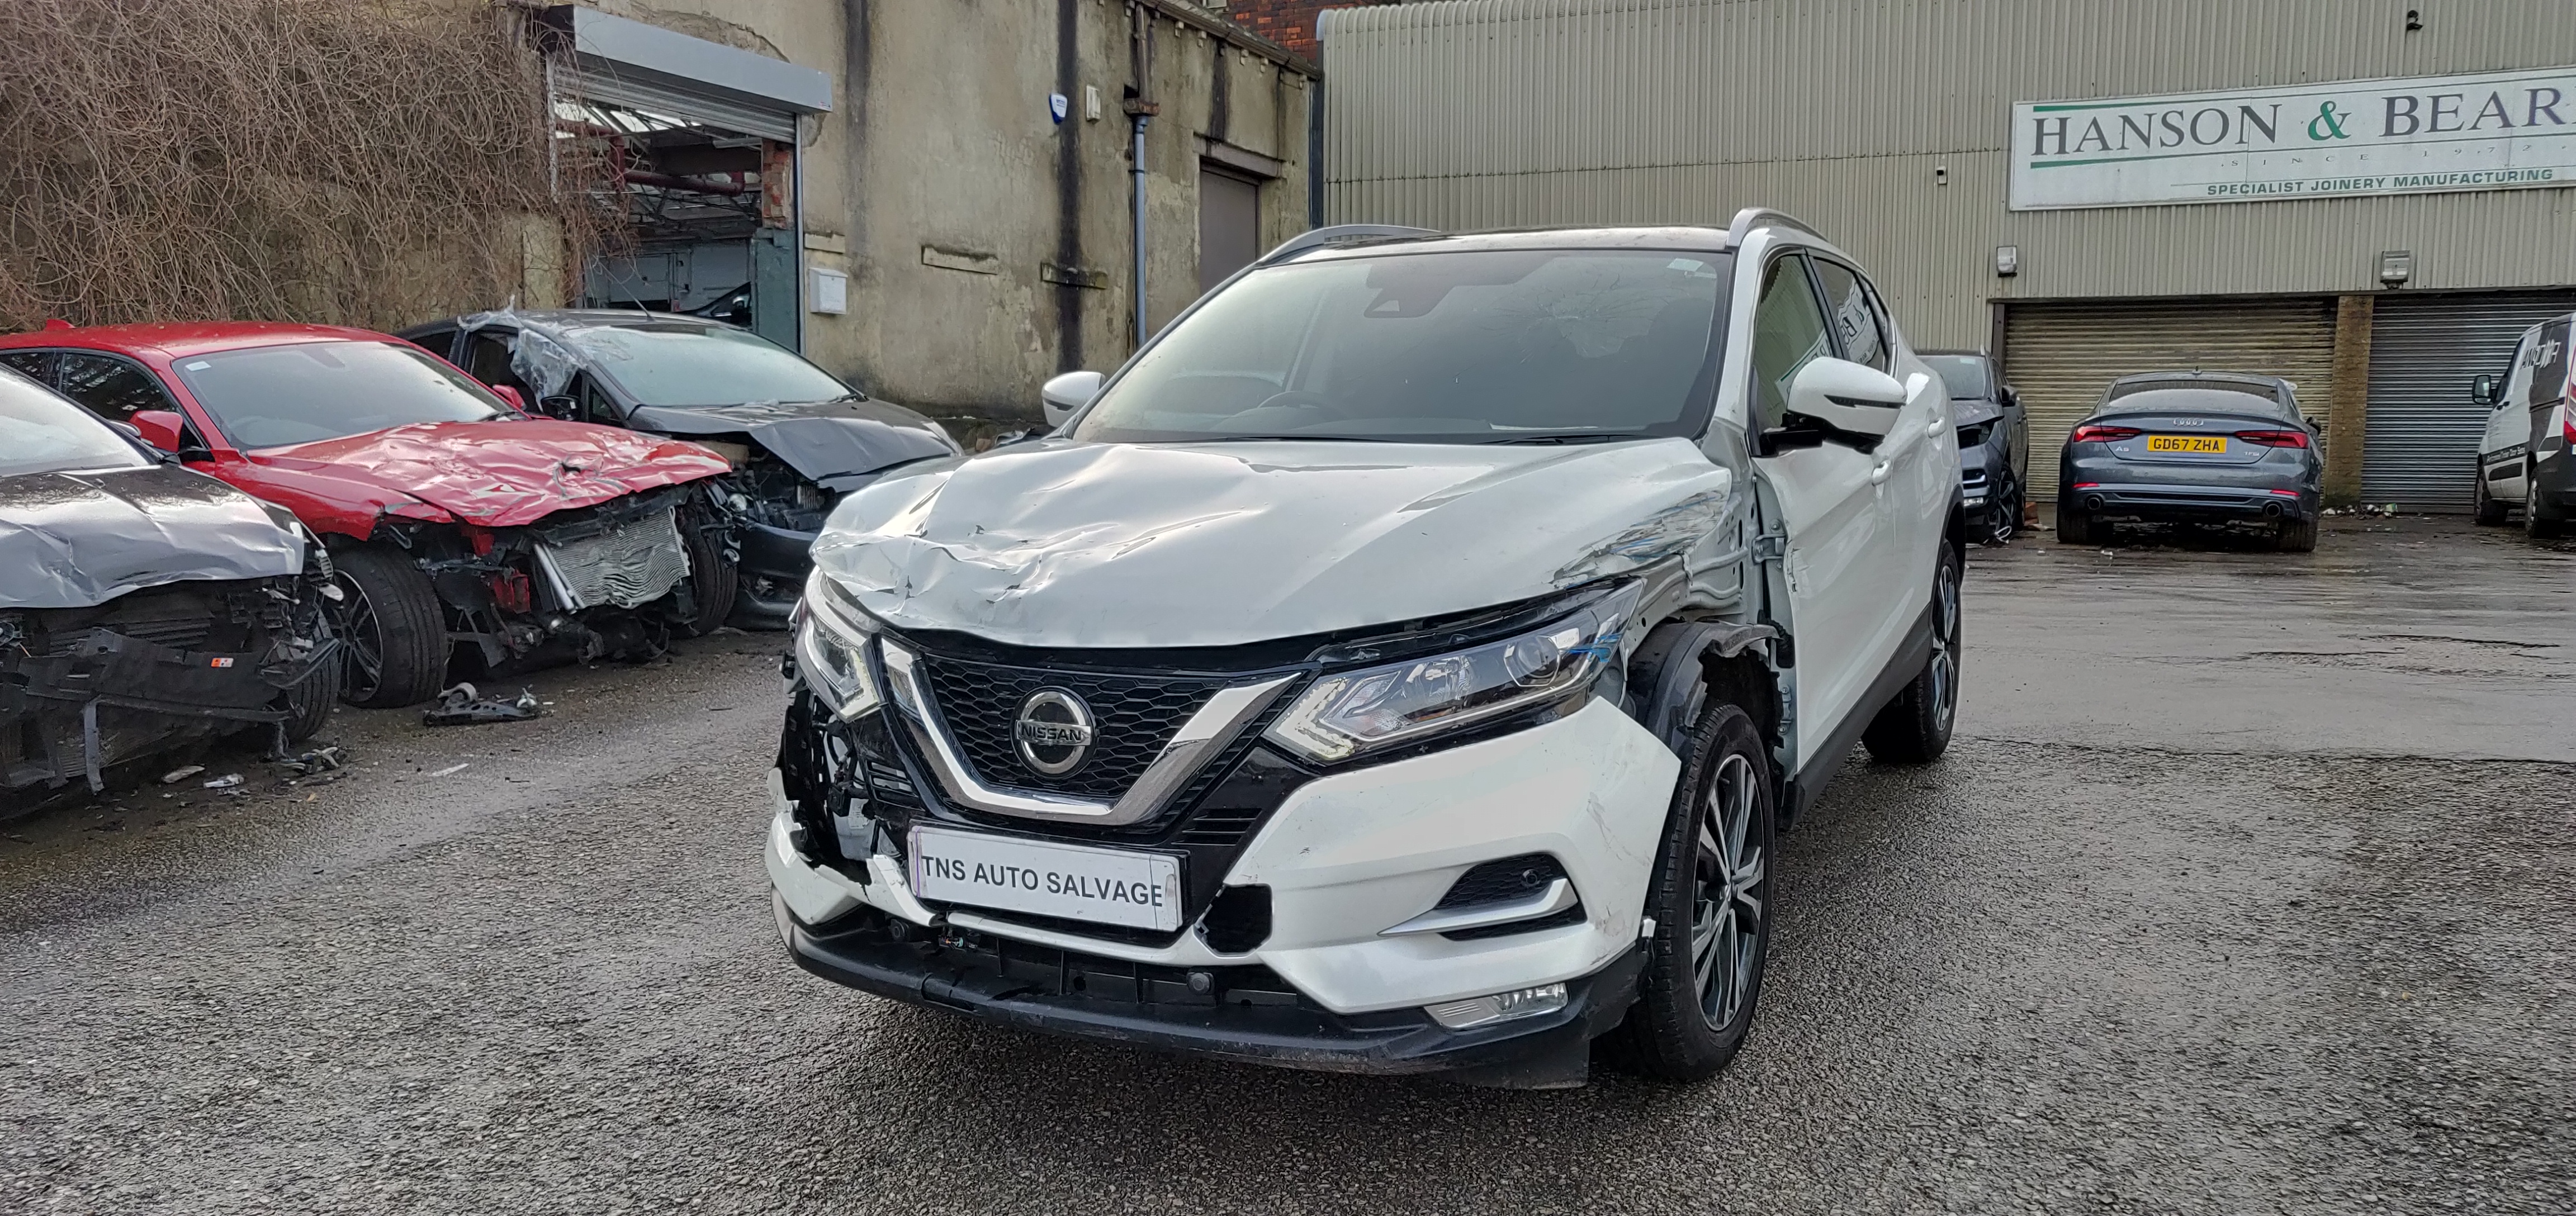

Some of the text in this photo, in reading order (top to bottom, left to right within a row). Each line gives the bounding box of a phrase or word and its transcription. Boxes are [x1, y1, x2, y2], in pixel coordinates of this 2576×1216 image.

[2031, 86, 2576, 156] HANSON & BEAR
[2208, 169, 2553, 195] SPECIALIST JOINERY MANUFACTURING
[2153, 439, 2219, 451] GD67 ZHA
[1021, 726, 1082, 741] NISSAN
[921, 856, 1162, 907] TNS AUTO SALVAGE
